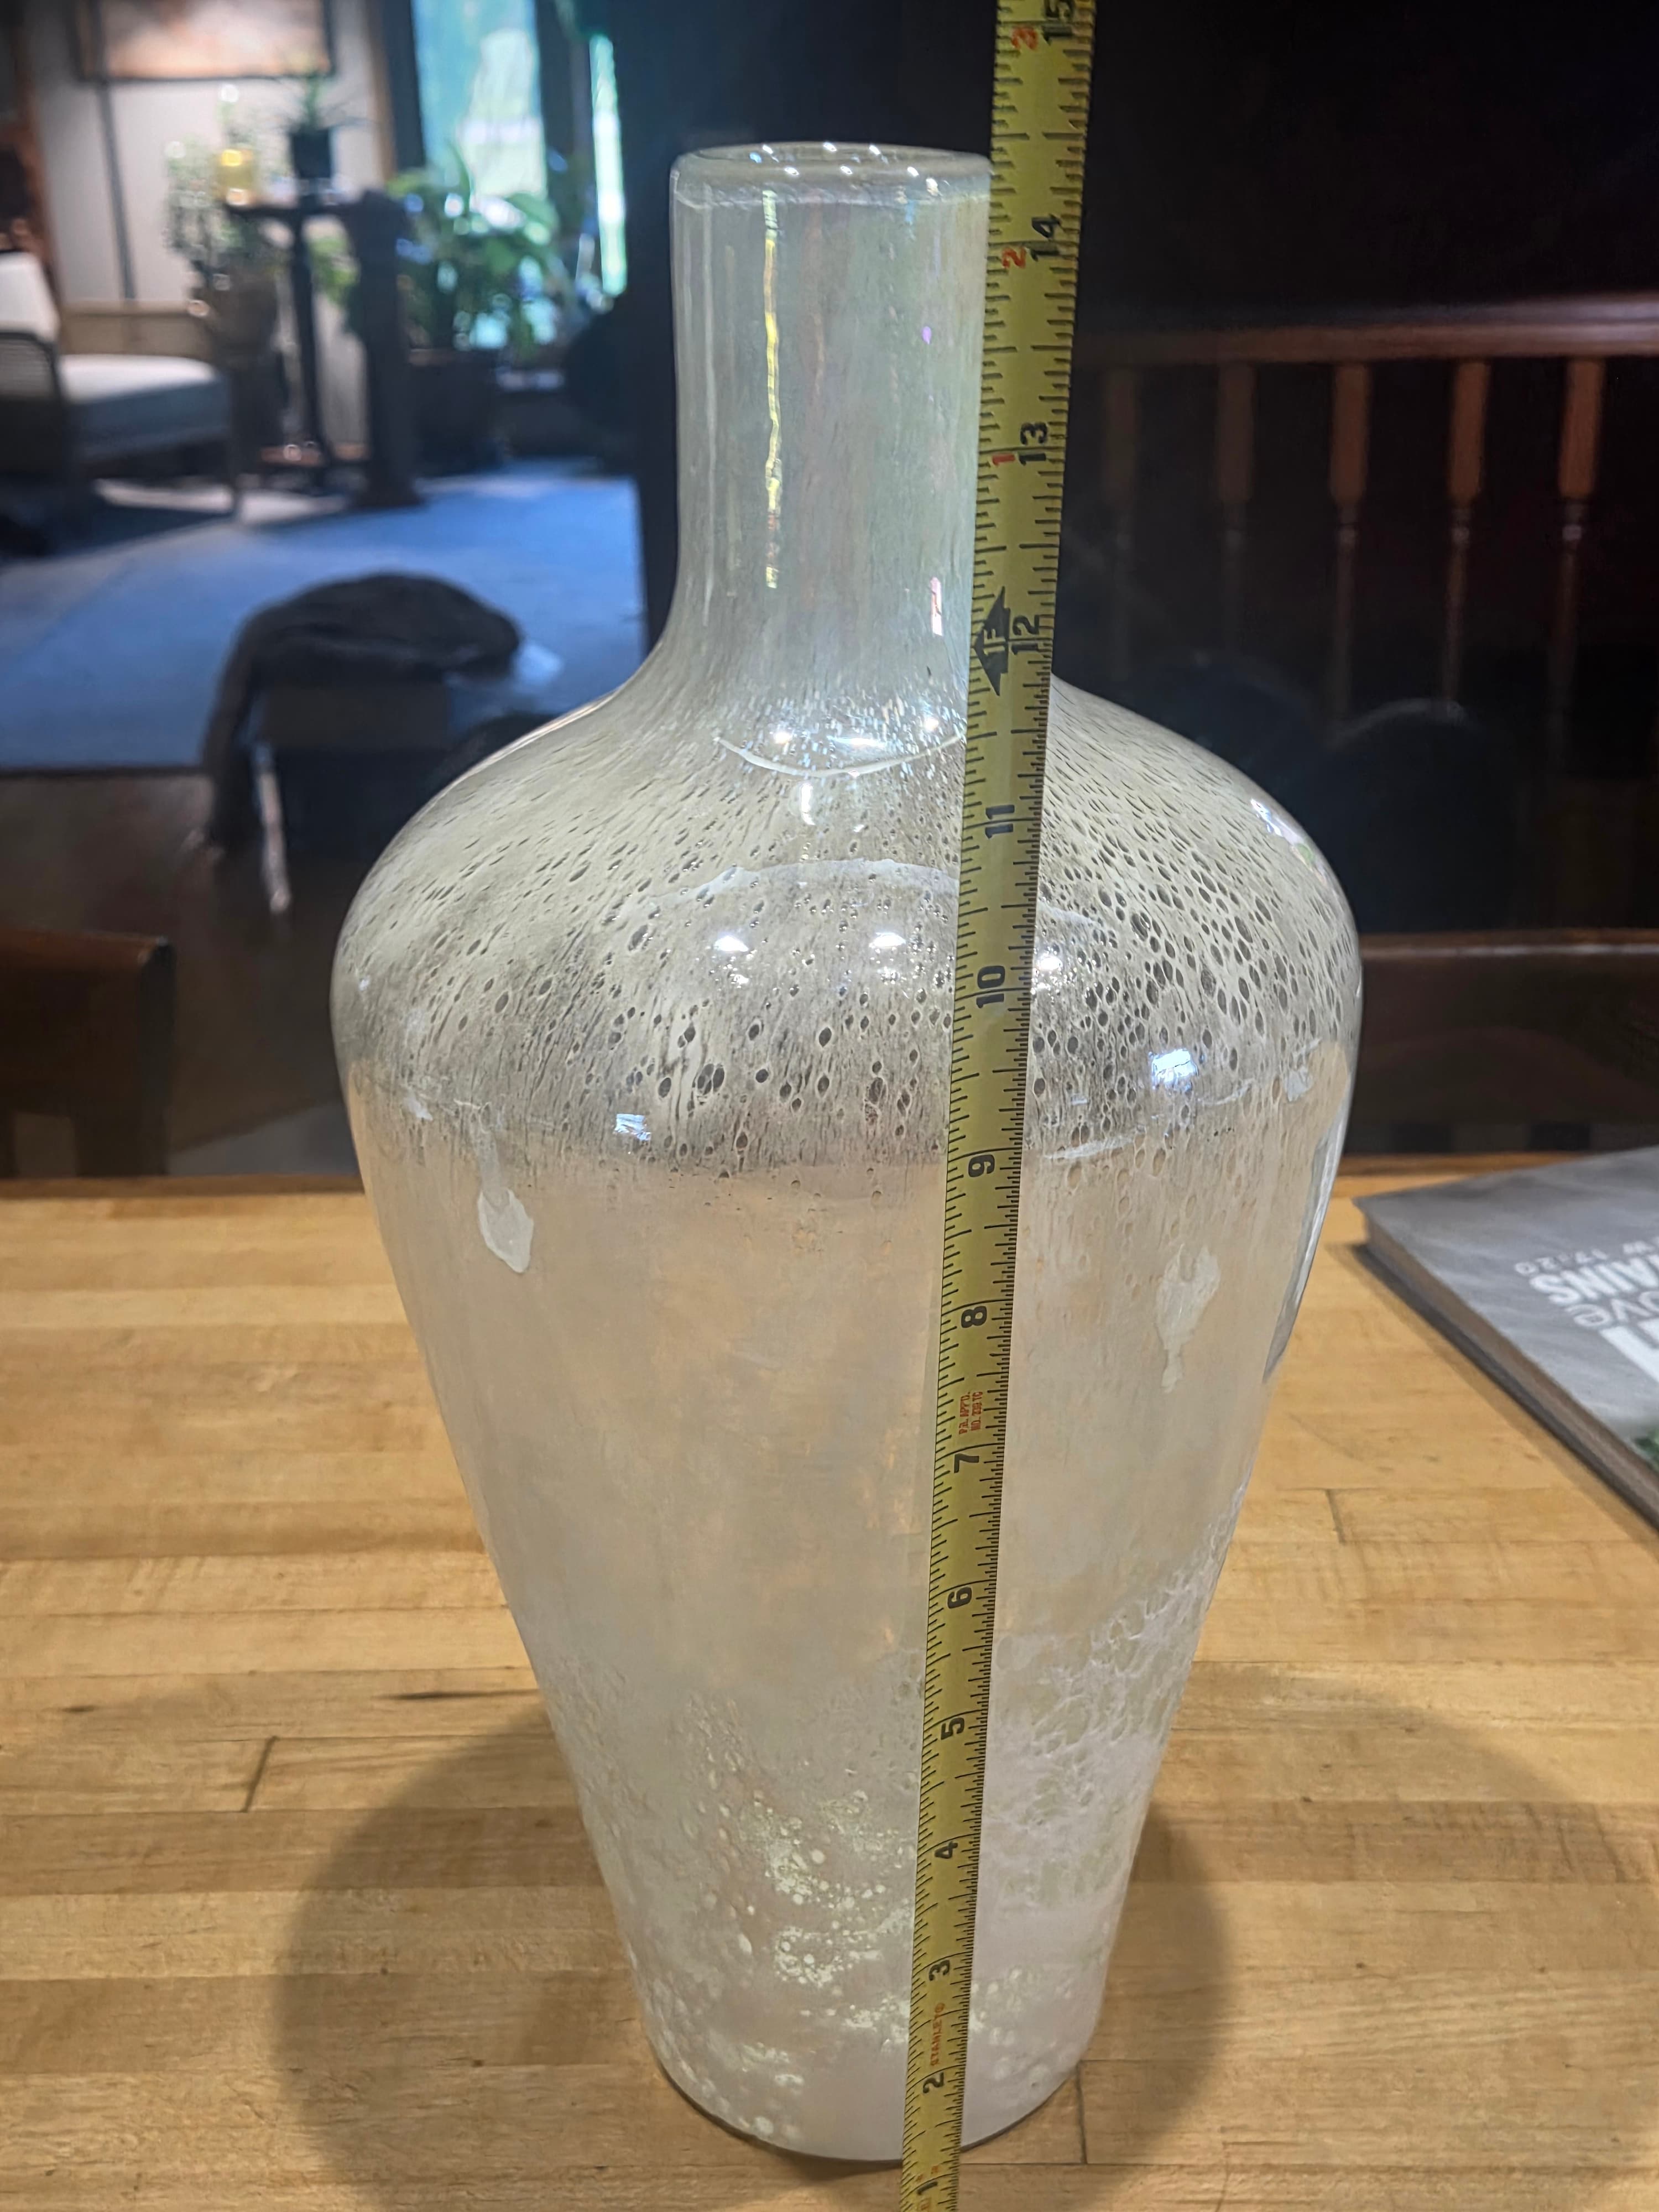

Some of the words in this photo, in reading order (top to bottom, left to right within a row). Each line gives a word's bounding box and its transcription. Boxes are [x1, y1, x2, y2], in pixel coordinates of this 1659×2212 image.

[1029, 213, 1061, 262] 14
[1001, 247, 1027, 269] 2
[1019, 421, 1049, 466] 13
[983, 629, 1006, 656] 1F
[1011, 614, 1040, 655] 12
[985, 804, 1015, 839] 11
[976, 965, 1005, 1009] 10
[968, 1154, 995, 1177] 9
[961, 1306, 987, 1328] 8
[954, 1453, 979, 1474] 7
[947, 1586, 972, 1609] 6
[940, 1717, 965, 1740] 5
[934, 1841, 958, 1859] 4
[928, 1959, 951, 1981] 3
[922, 2072, 945, 2094] 2
[916, 2180, 938, 2196] 1
